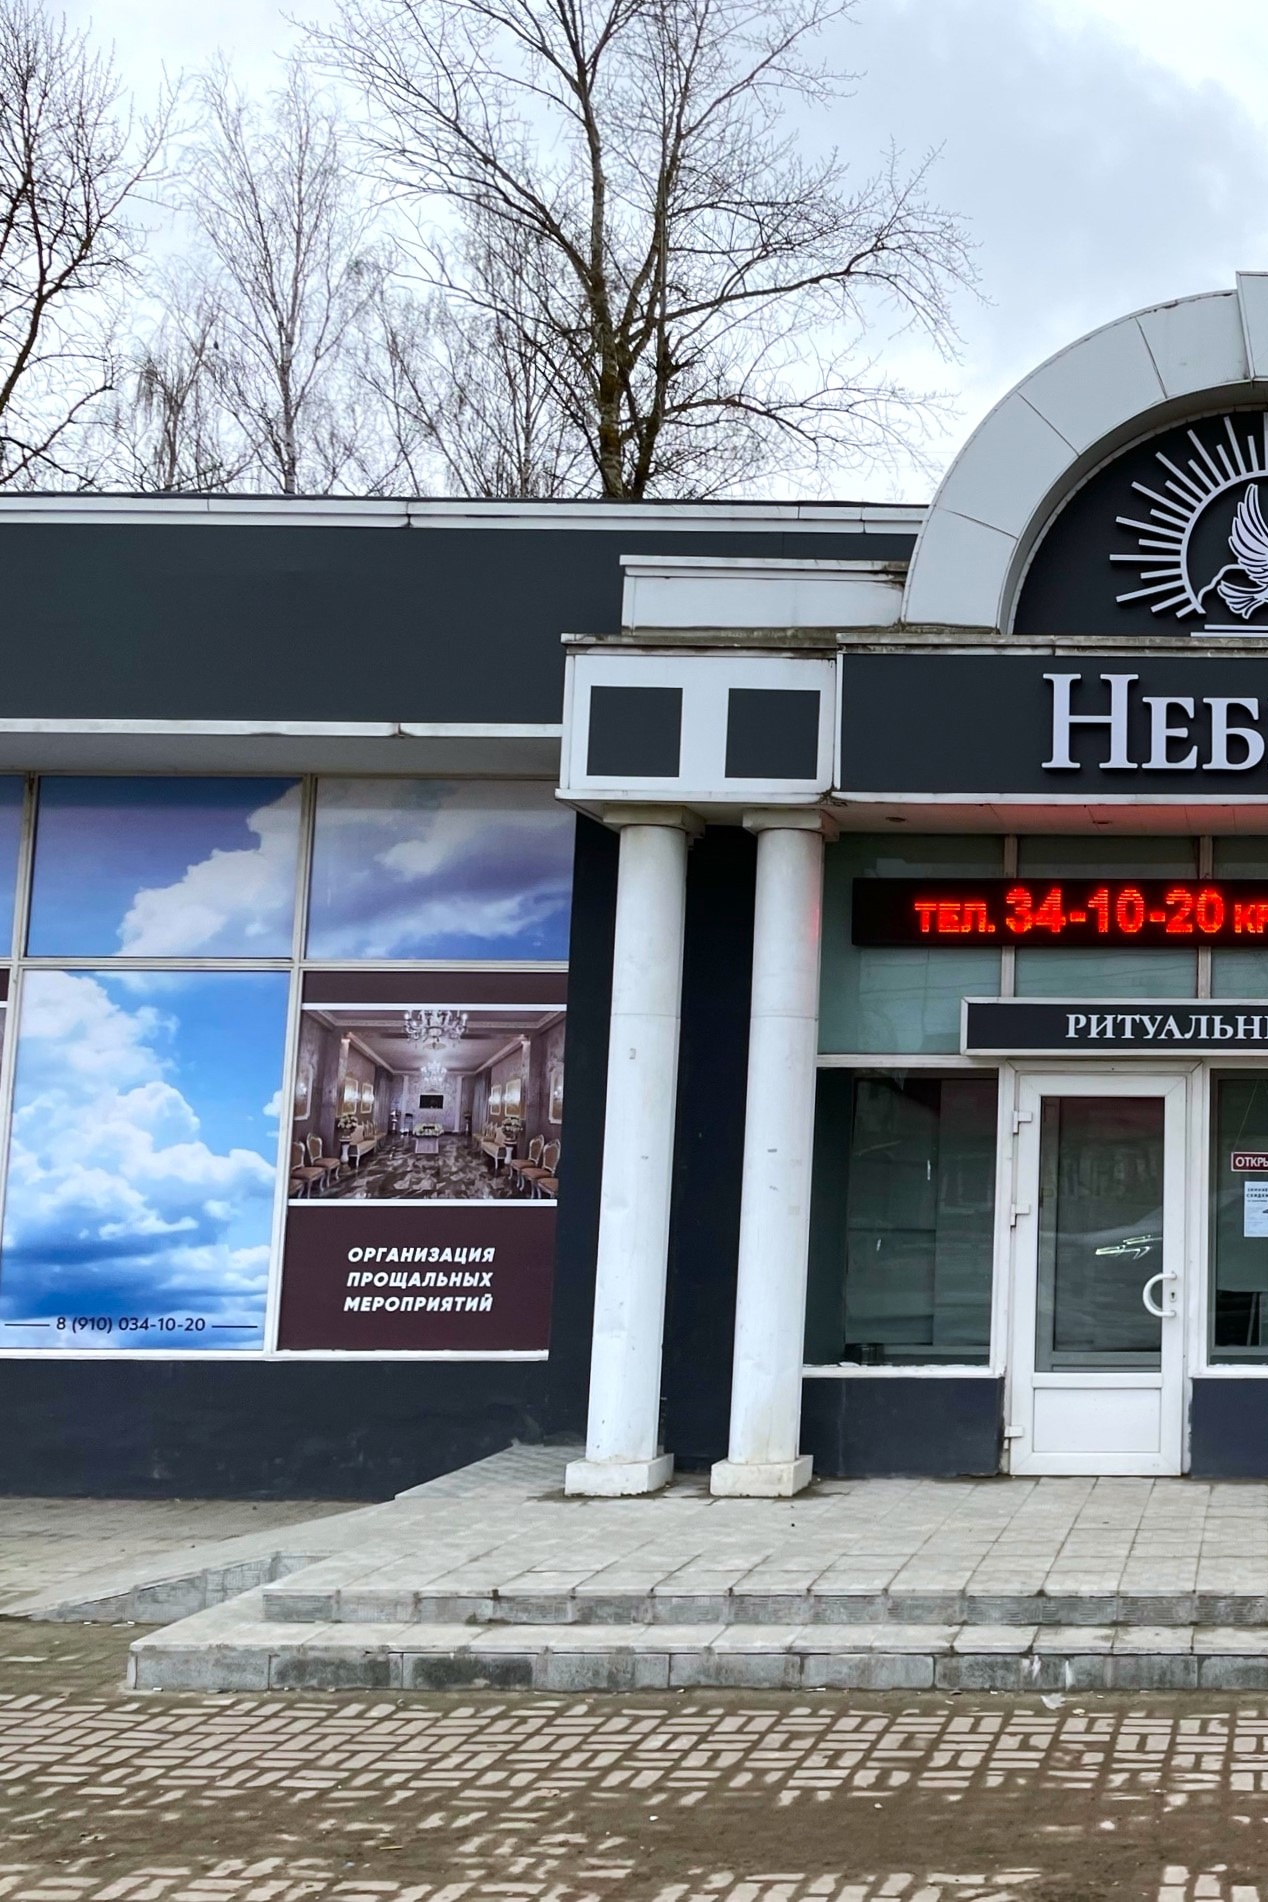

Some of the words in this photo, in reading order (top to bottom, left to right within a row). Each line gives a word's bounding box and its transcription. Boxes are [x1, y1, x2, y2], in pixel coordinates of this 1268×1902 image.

[1005, 888, 1224, 934] 34-10-20
[347, 1247, 496, 1265] ОРГАНИЗАЦИЯ
[346, 1271, 494, 1289] ПРОЩАЛЬНЫХ
[343, 1294, 494, 1312] МЕРОПРИЯТИЙ
[56, 1316, 66, 1331] 8
[72, 1316, 113, 1334] (910)
[118, 1316, 206, 1332] 034-10-20
